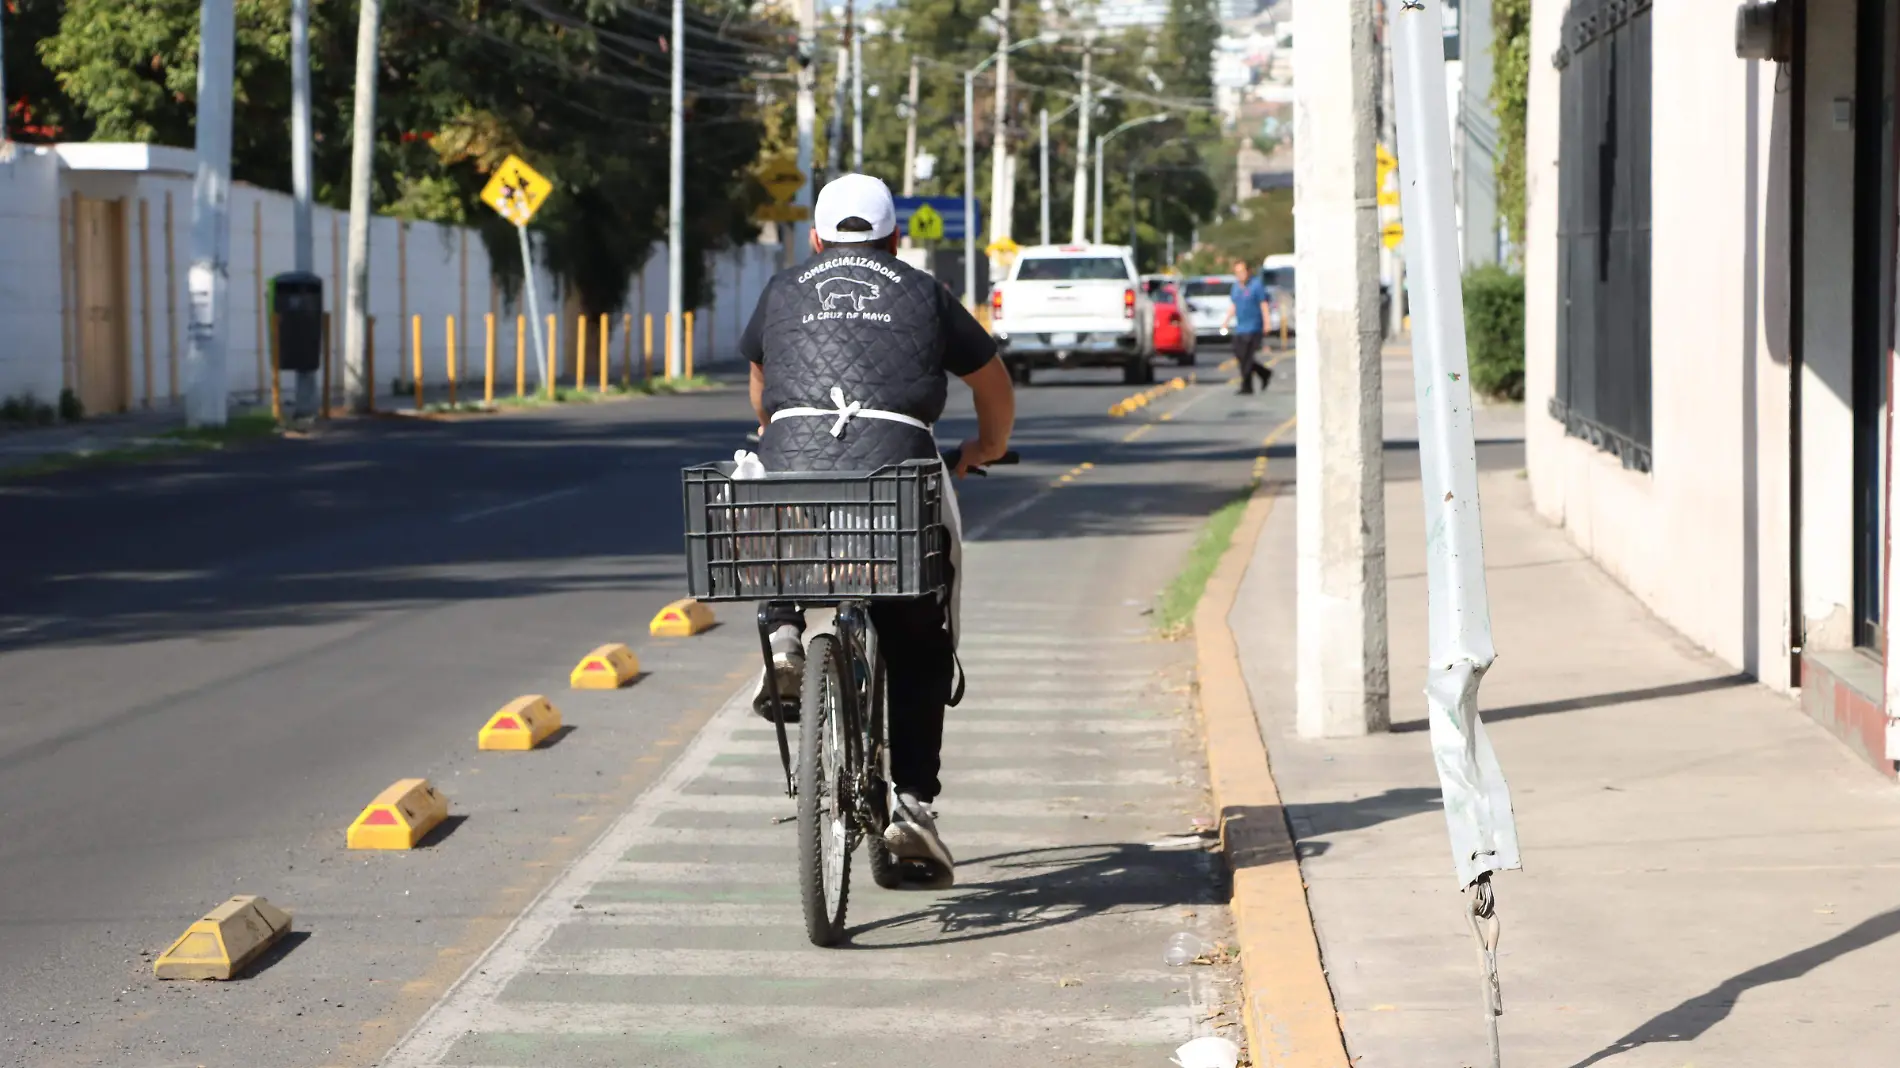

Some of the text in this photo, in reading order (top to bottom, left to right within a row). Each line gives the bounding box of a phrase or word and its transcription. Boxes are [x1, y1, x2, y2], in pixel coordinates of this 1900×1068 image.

[798, 256, 902, 284] COMERCIALIZADORA
[802, 311, 892, 324] LA CRUZ DE MAYO
